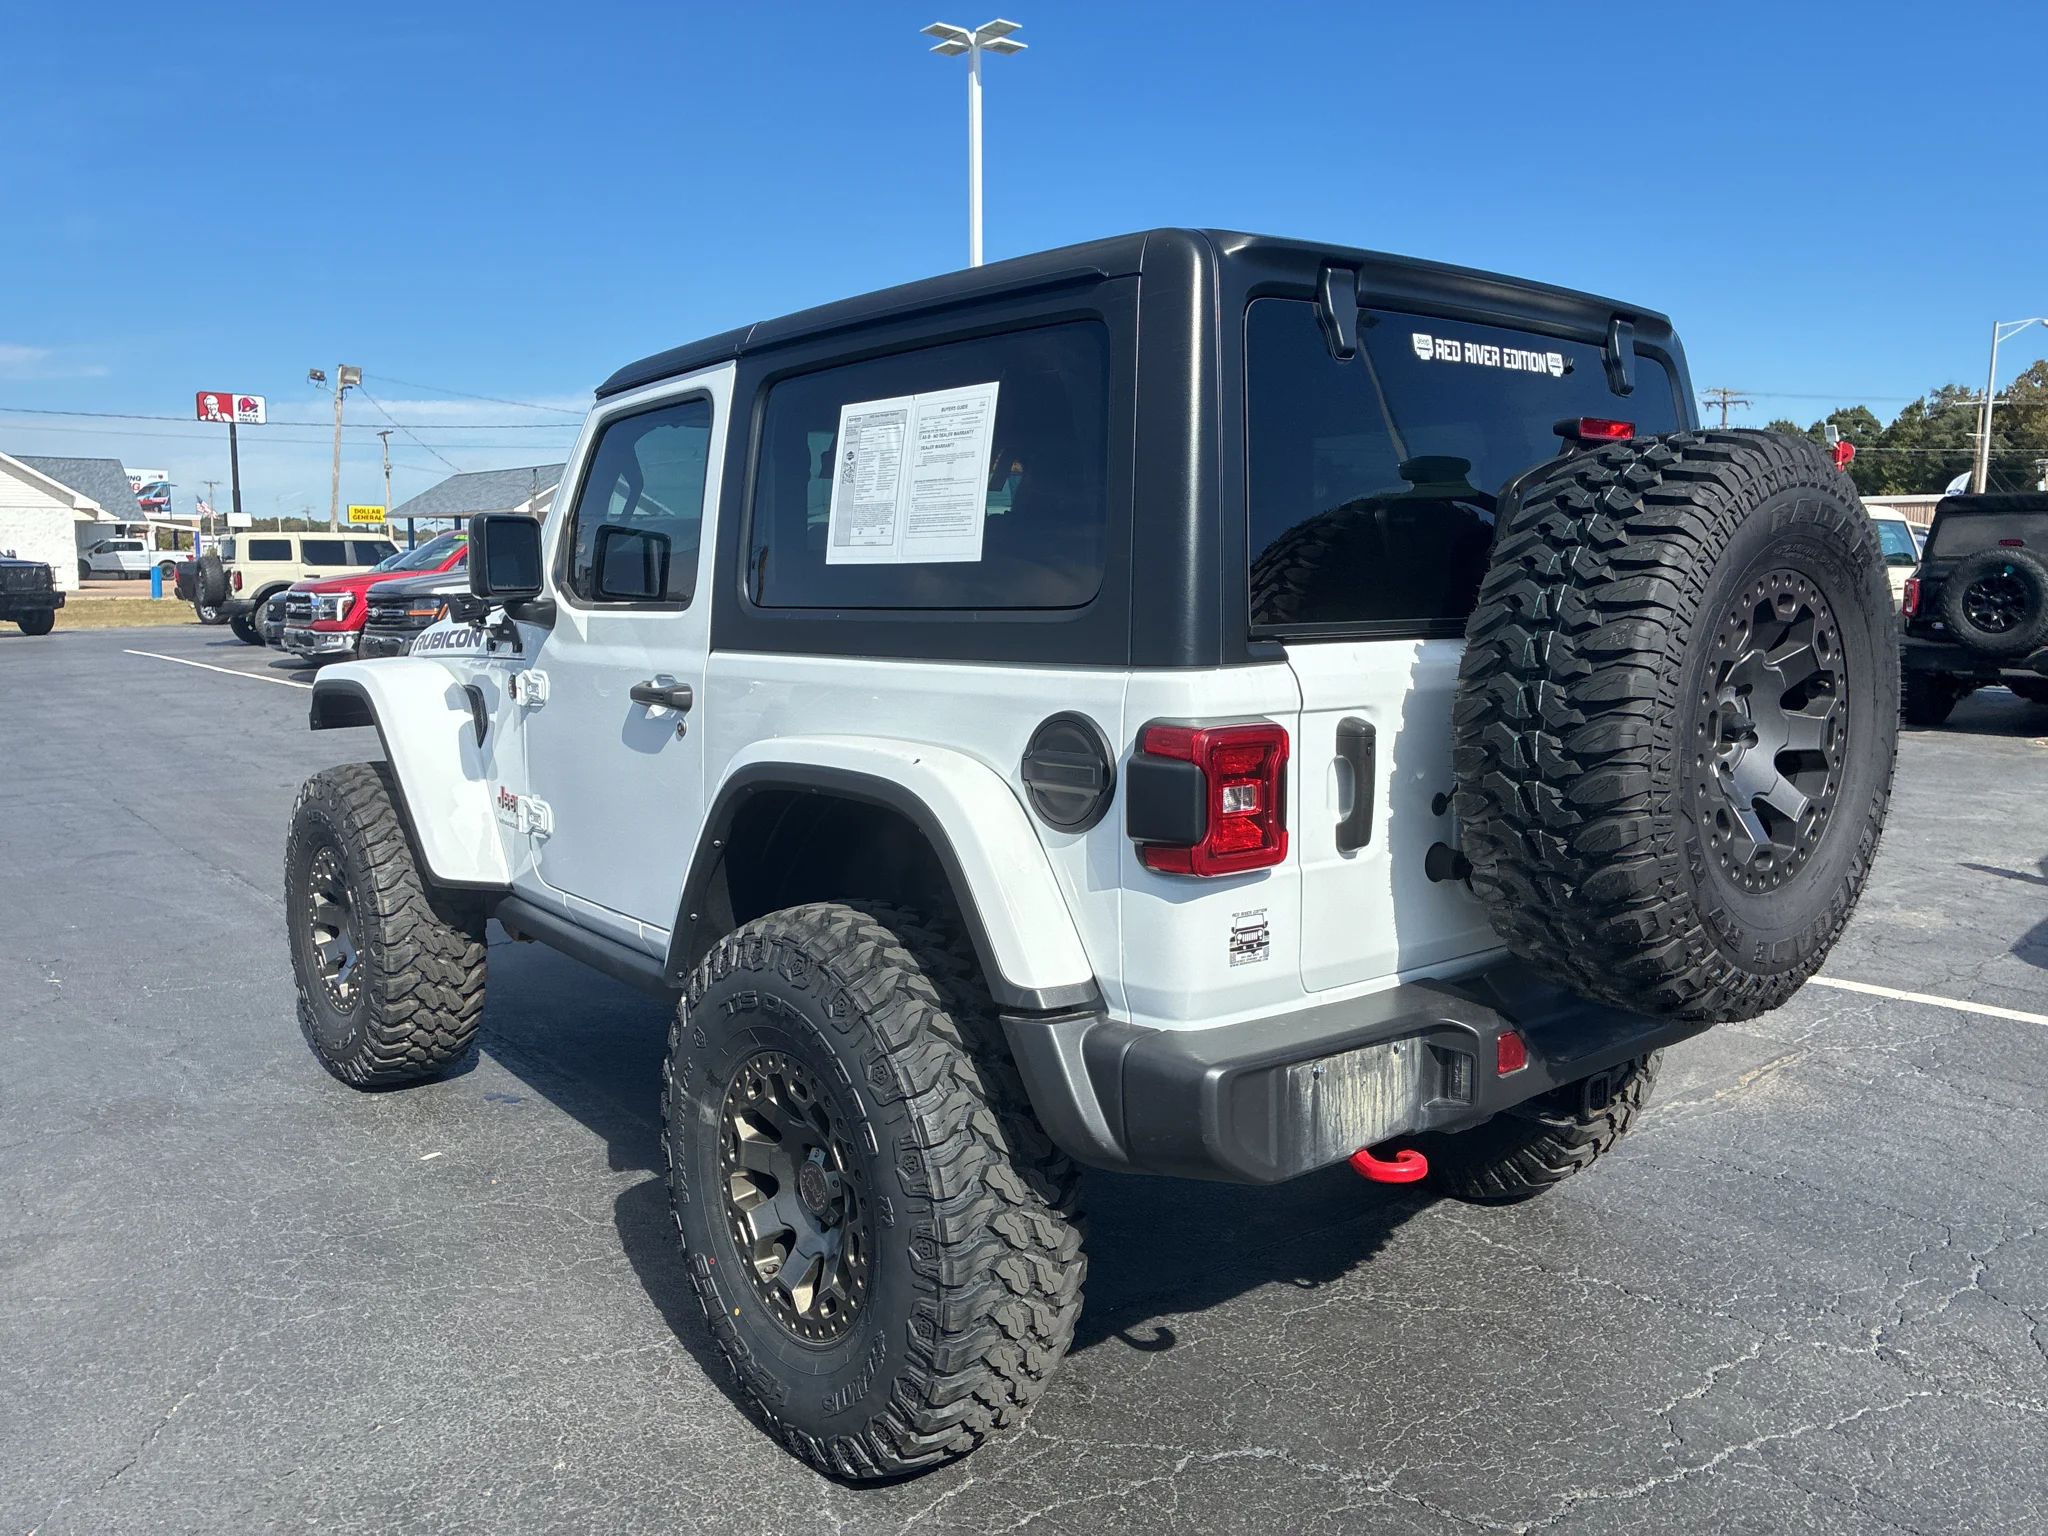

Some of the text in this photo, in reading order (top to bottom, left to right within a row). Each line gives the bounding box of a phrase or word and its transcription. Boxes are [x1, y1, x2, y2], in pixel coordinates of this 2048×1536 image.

[1416, 335, 1431, 347] Jeep
[1435, 338, 1461, 362] RED
[1465, 342, 1500, 367] RIVER
[1503, 348, 1547, 373] EDITION
[413, 629, 483, 651] RUBICON
[693, 1252, 792, 1408] HERCULES
